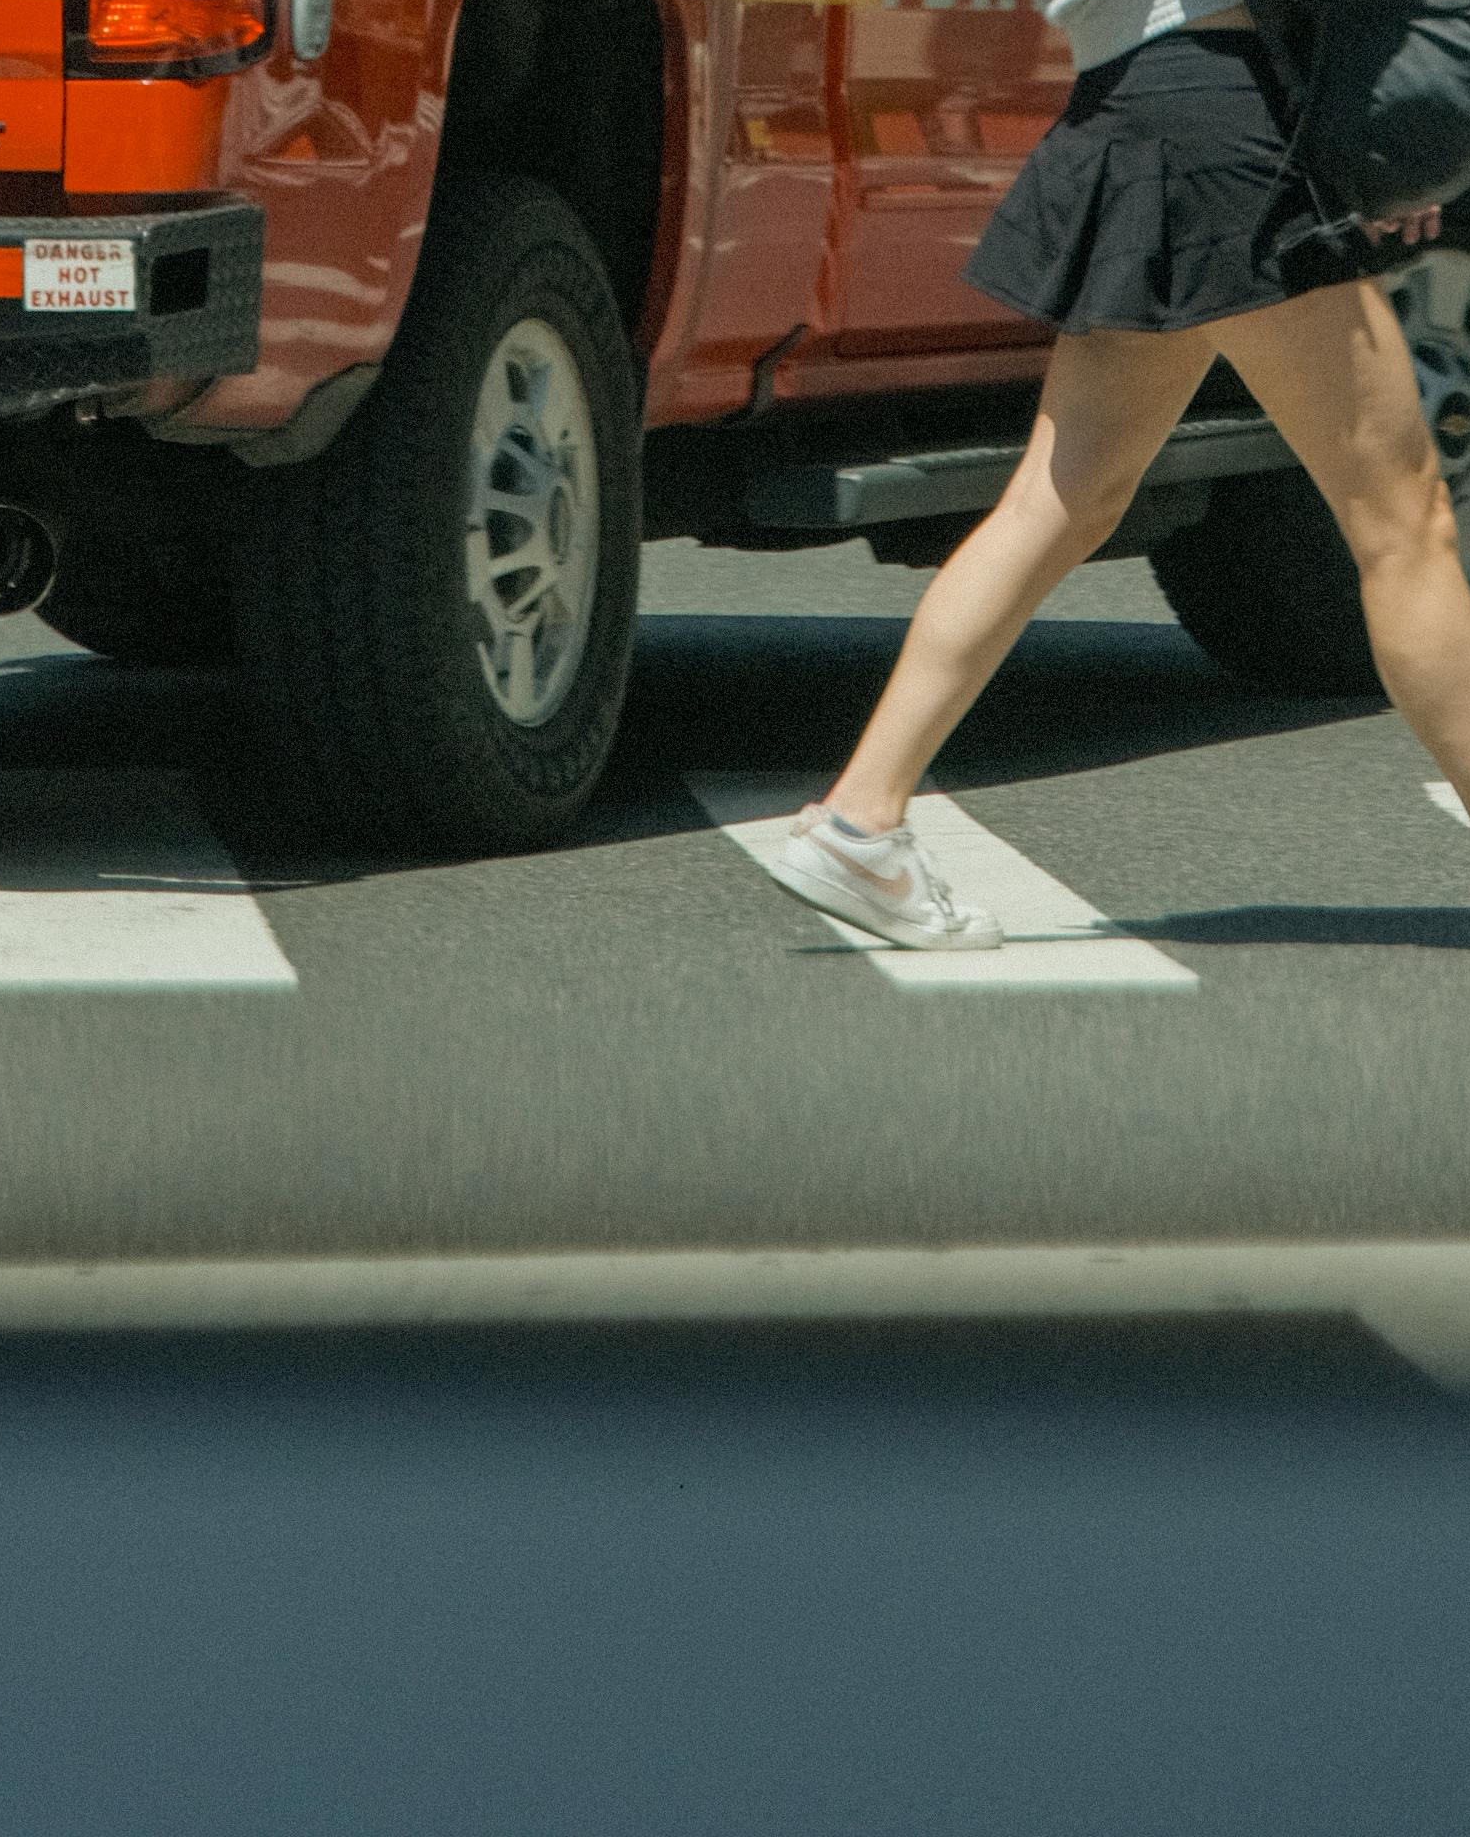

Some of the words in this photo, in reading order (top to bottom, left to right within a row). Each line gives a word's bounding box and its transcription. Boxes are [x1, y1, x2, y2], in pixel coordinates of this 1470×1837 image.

[34, 243, 123, 261] DANGER
[58, 267, 101, 284] HOT
[31, 290, 130, 309] EXHAUST
